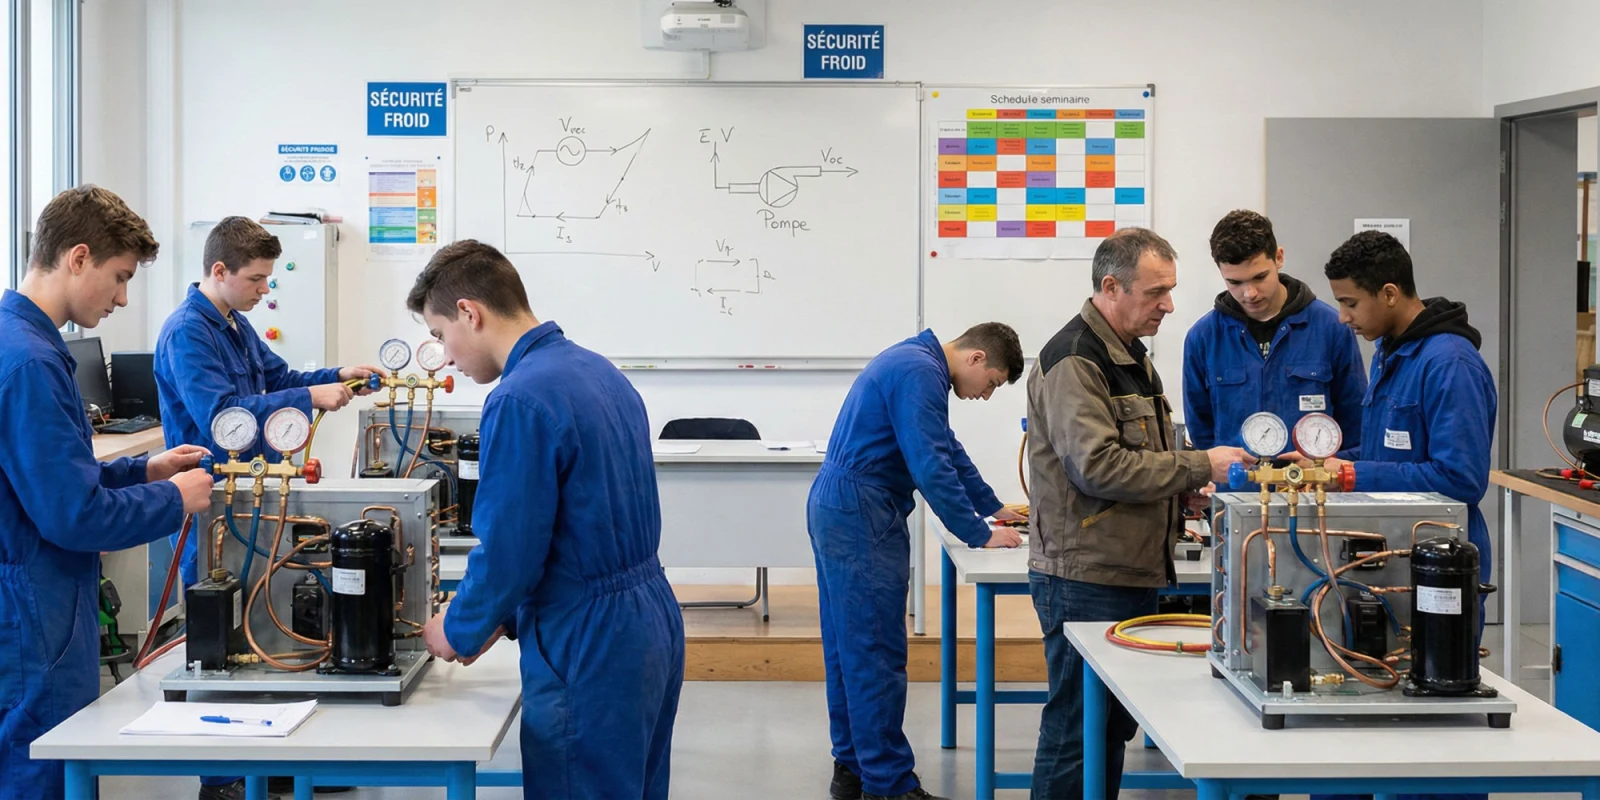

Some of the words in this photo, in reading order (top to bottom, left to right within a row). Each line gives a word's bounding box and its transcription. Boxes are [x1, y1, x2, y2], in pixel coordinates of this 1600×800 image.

[807, 29, 880, 50] SÉCURITÉ
[821, 55, 866, 70] FROID
[370, 87, 444, 107] SÉCURITÉ
[384, 112, 430, 128] FROID
[757, 209, 811, 237] Pompe
